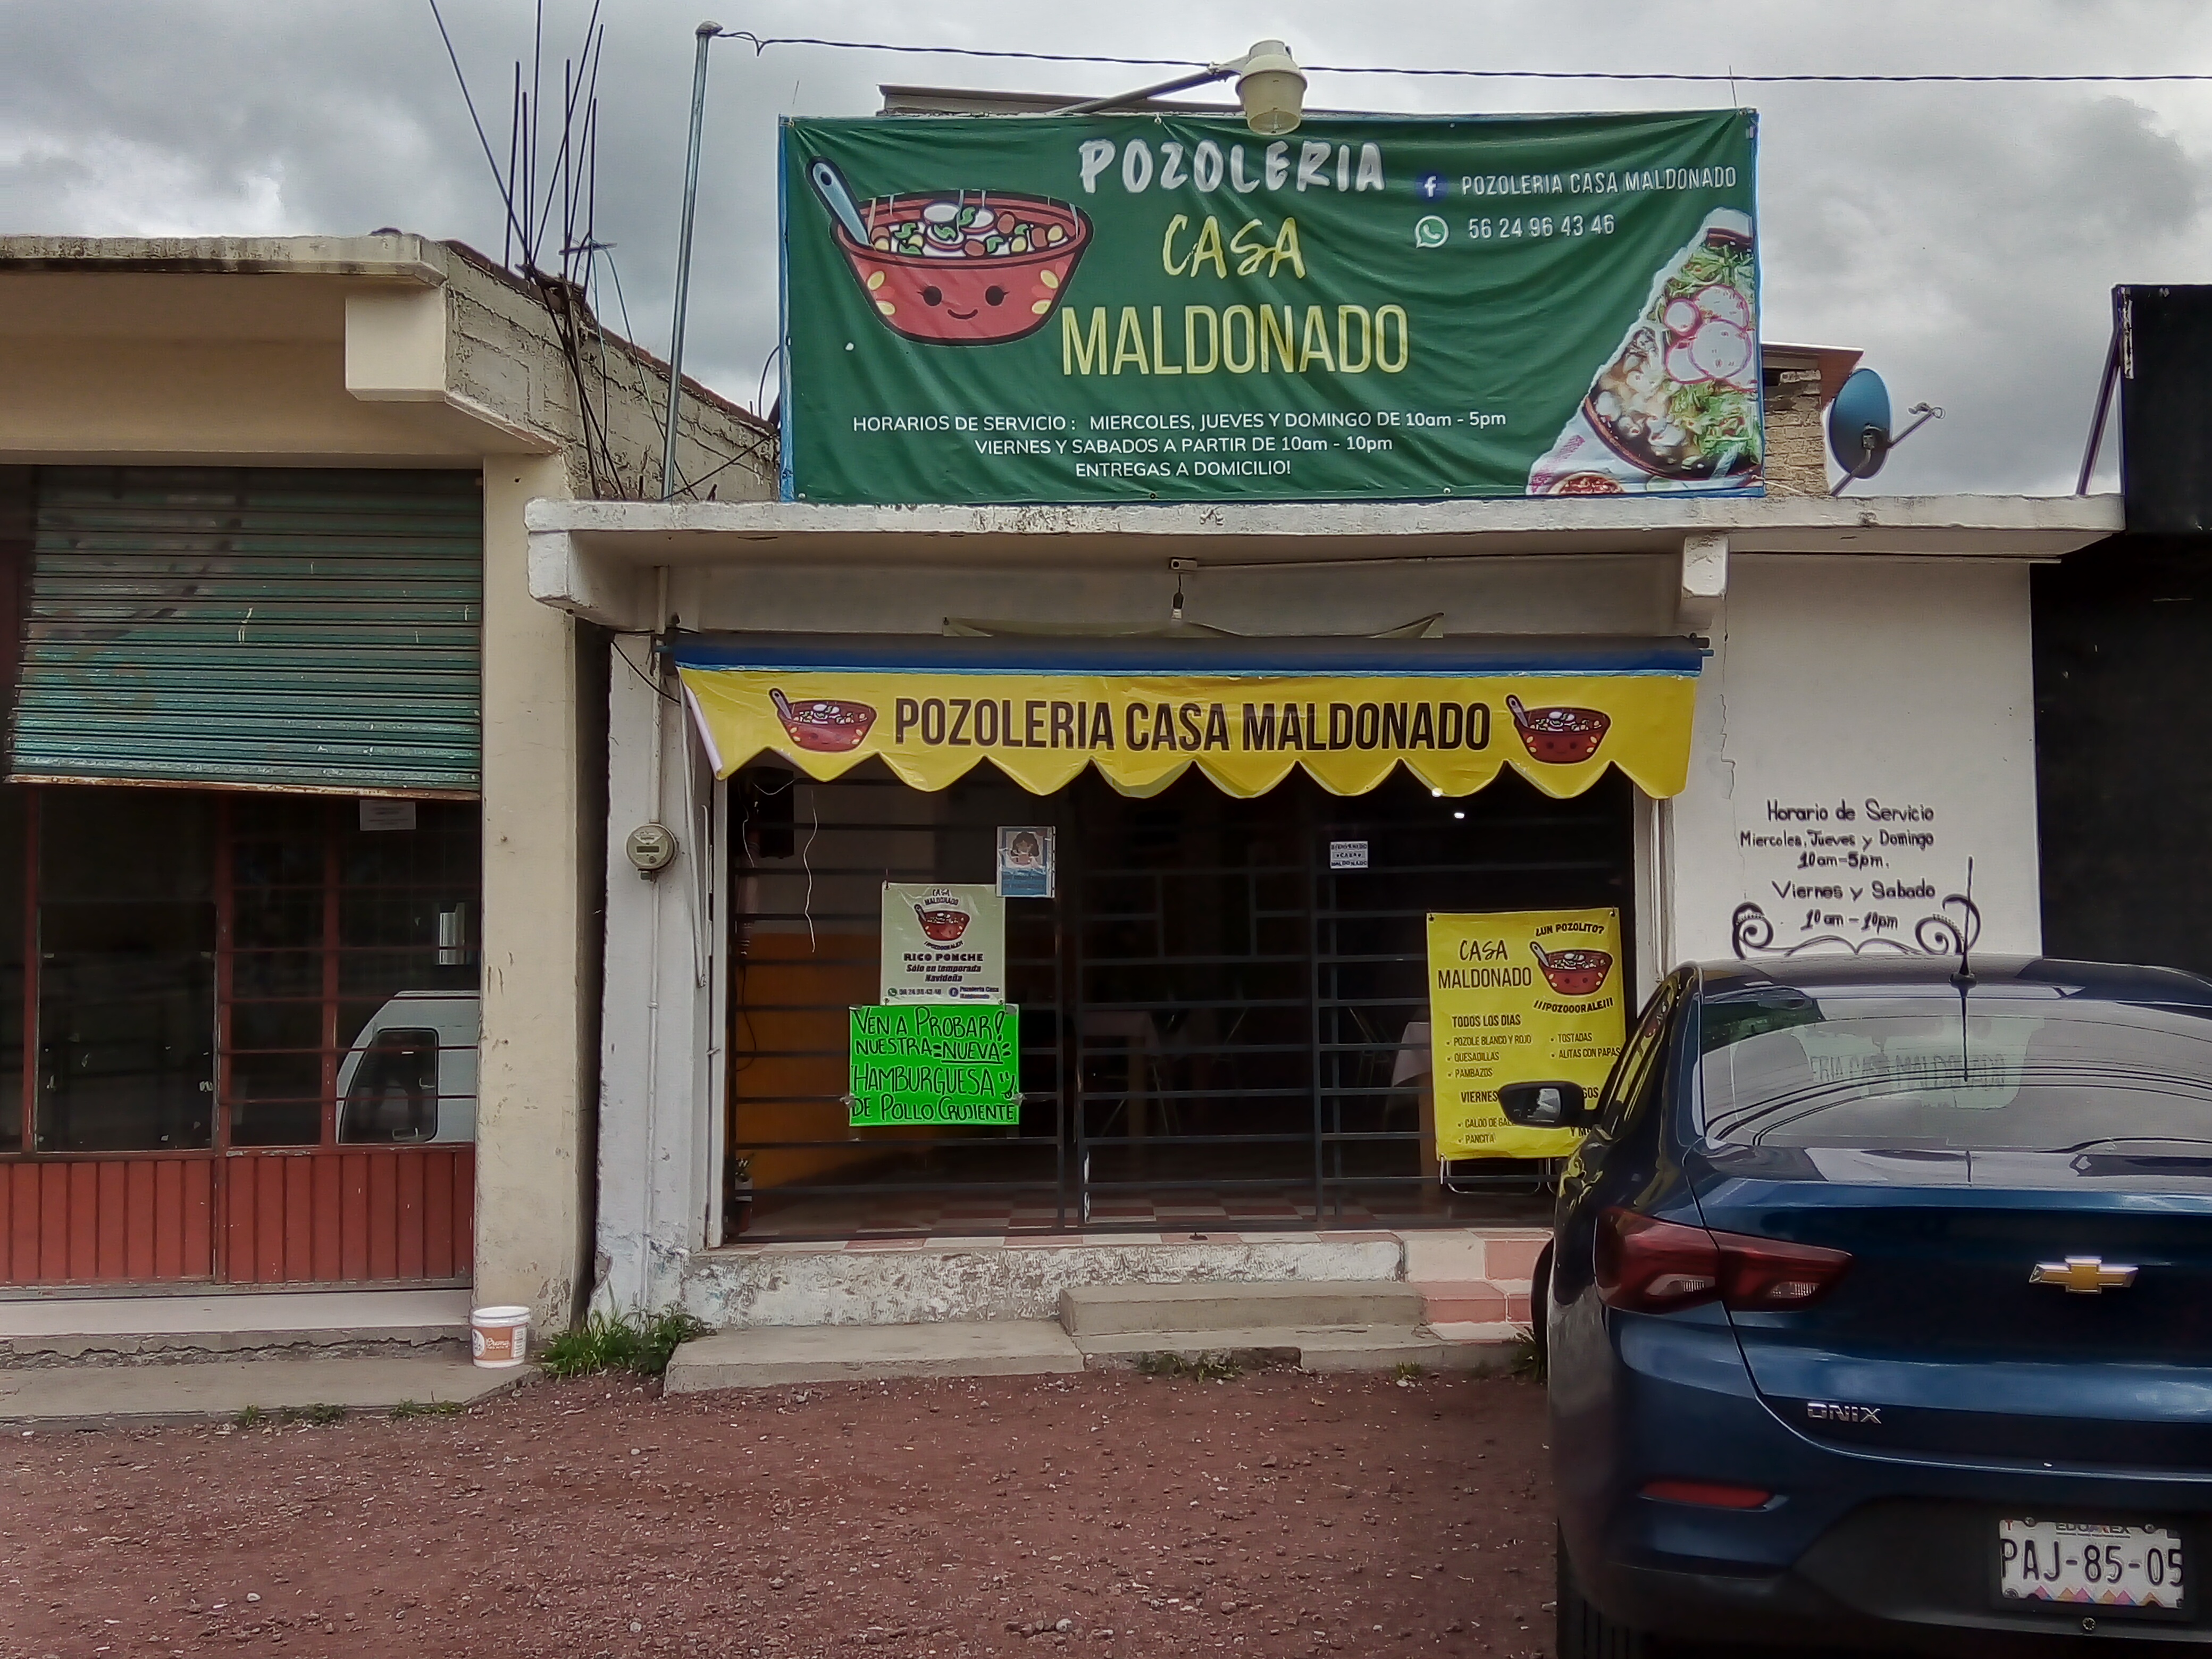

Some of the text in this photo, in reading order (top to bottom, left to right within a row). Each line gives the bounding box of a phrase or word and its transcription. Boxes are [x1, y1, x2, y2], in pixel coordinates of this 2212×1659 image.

[1078, 138, 1385, 193] POZOLERIA
[1461, 166, 1737, 196] POZOLERIA CASA MALDONADO
[1468, 214, 1615, 239] 56 24 96 43 46
[1162, 214, 1306, 279] CASA
[1062, 304, 1409, 375] MALDONADO
[853, 415, 950, 432] HORARIOS
[955, 416, 978, 431] DE
[983, 415, 1066, 431] SERVICIO
[1090, 414, 1195, 431] MIERCOLES,
[1200, 413, 1264, 432] JUEVES
[1269, 413, 1280, 428] Y
[1285, 412, 1371, 428] DOMINGO
[1377, 412, 1401, 426] DE
[1406, 411, 1452, 427] 10am
[1469, 411, 1506, 430] 5pm
[974, 440, 1051, 455] VIERNES
[1055, 439, 1067, 455] Y
[1072, 438, 1158, 454] SABADOS
[1163, 438, 1177, 453] A
[1183, 437, 1246, 453] PARTIR
[1252, 437, 1275, 451] DE
[1281, 435, 1327, 451] 10am
[1346, 435, 1393, 454] 10pm
[1076, 460, 1291, 477] ENTREGAS A DOMICILIO!
[894, 697, 1491, 752] POZOLERIA CASA MALDONADO
[1767, 798, 1934, 822] Horario de Servicio
[1740, 829, 1934, 851] Miercoles, Jueves y Domingo
[1772, 878, 1936, 902] Viernes y Sabado
[1536, 923, 1604, 936] ¿UN POZOLITO?
[1460, 940, 1508, 961] CASA
[1438, 967, 1531, 989] MALDONADO
[896, 1015, 908, 1035] A
[1452, 1014, 1521, 1028] TODOS LOS DIAS
[856, 1037, 932, 1056] NUESTRA
[1454, 1034, 1531, 1046] POZOLE BLANCO Y ROJO
[1557, 1033, 1592, 1043] TOSTADAS
[1454, 1051, 1499, 1062] QUESADILLAS
[1559, 1047, 1621, 1058] ALITAS CON PAPAS
[853, 1063, 995, 1096] HAMBURGUESA
[1455, 1068, 1493, 1078] PAMBAZOS
[852, 1097, 871, 1117] DE
[882, 1094, 934, 1120] POLLO
[1461, 1091, 1498, 1102] VIERNES
[1465, 1118, 1487, 1128] CALDO
[1489, 1118, 1497, 1127] DE
[1465, 1134, 1495, 1144] PANCITA
[1807, 1403, 1882, 1424] ONIX
